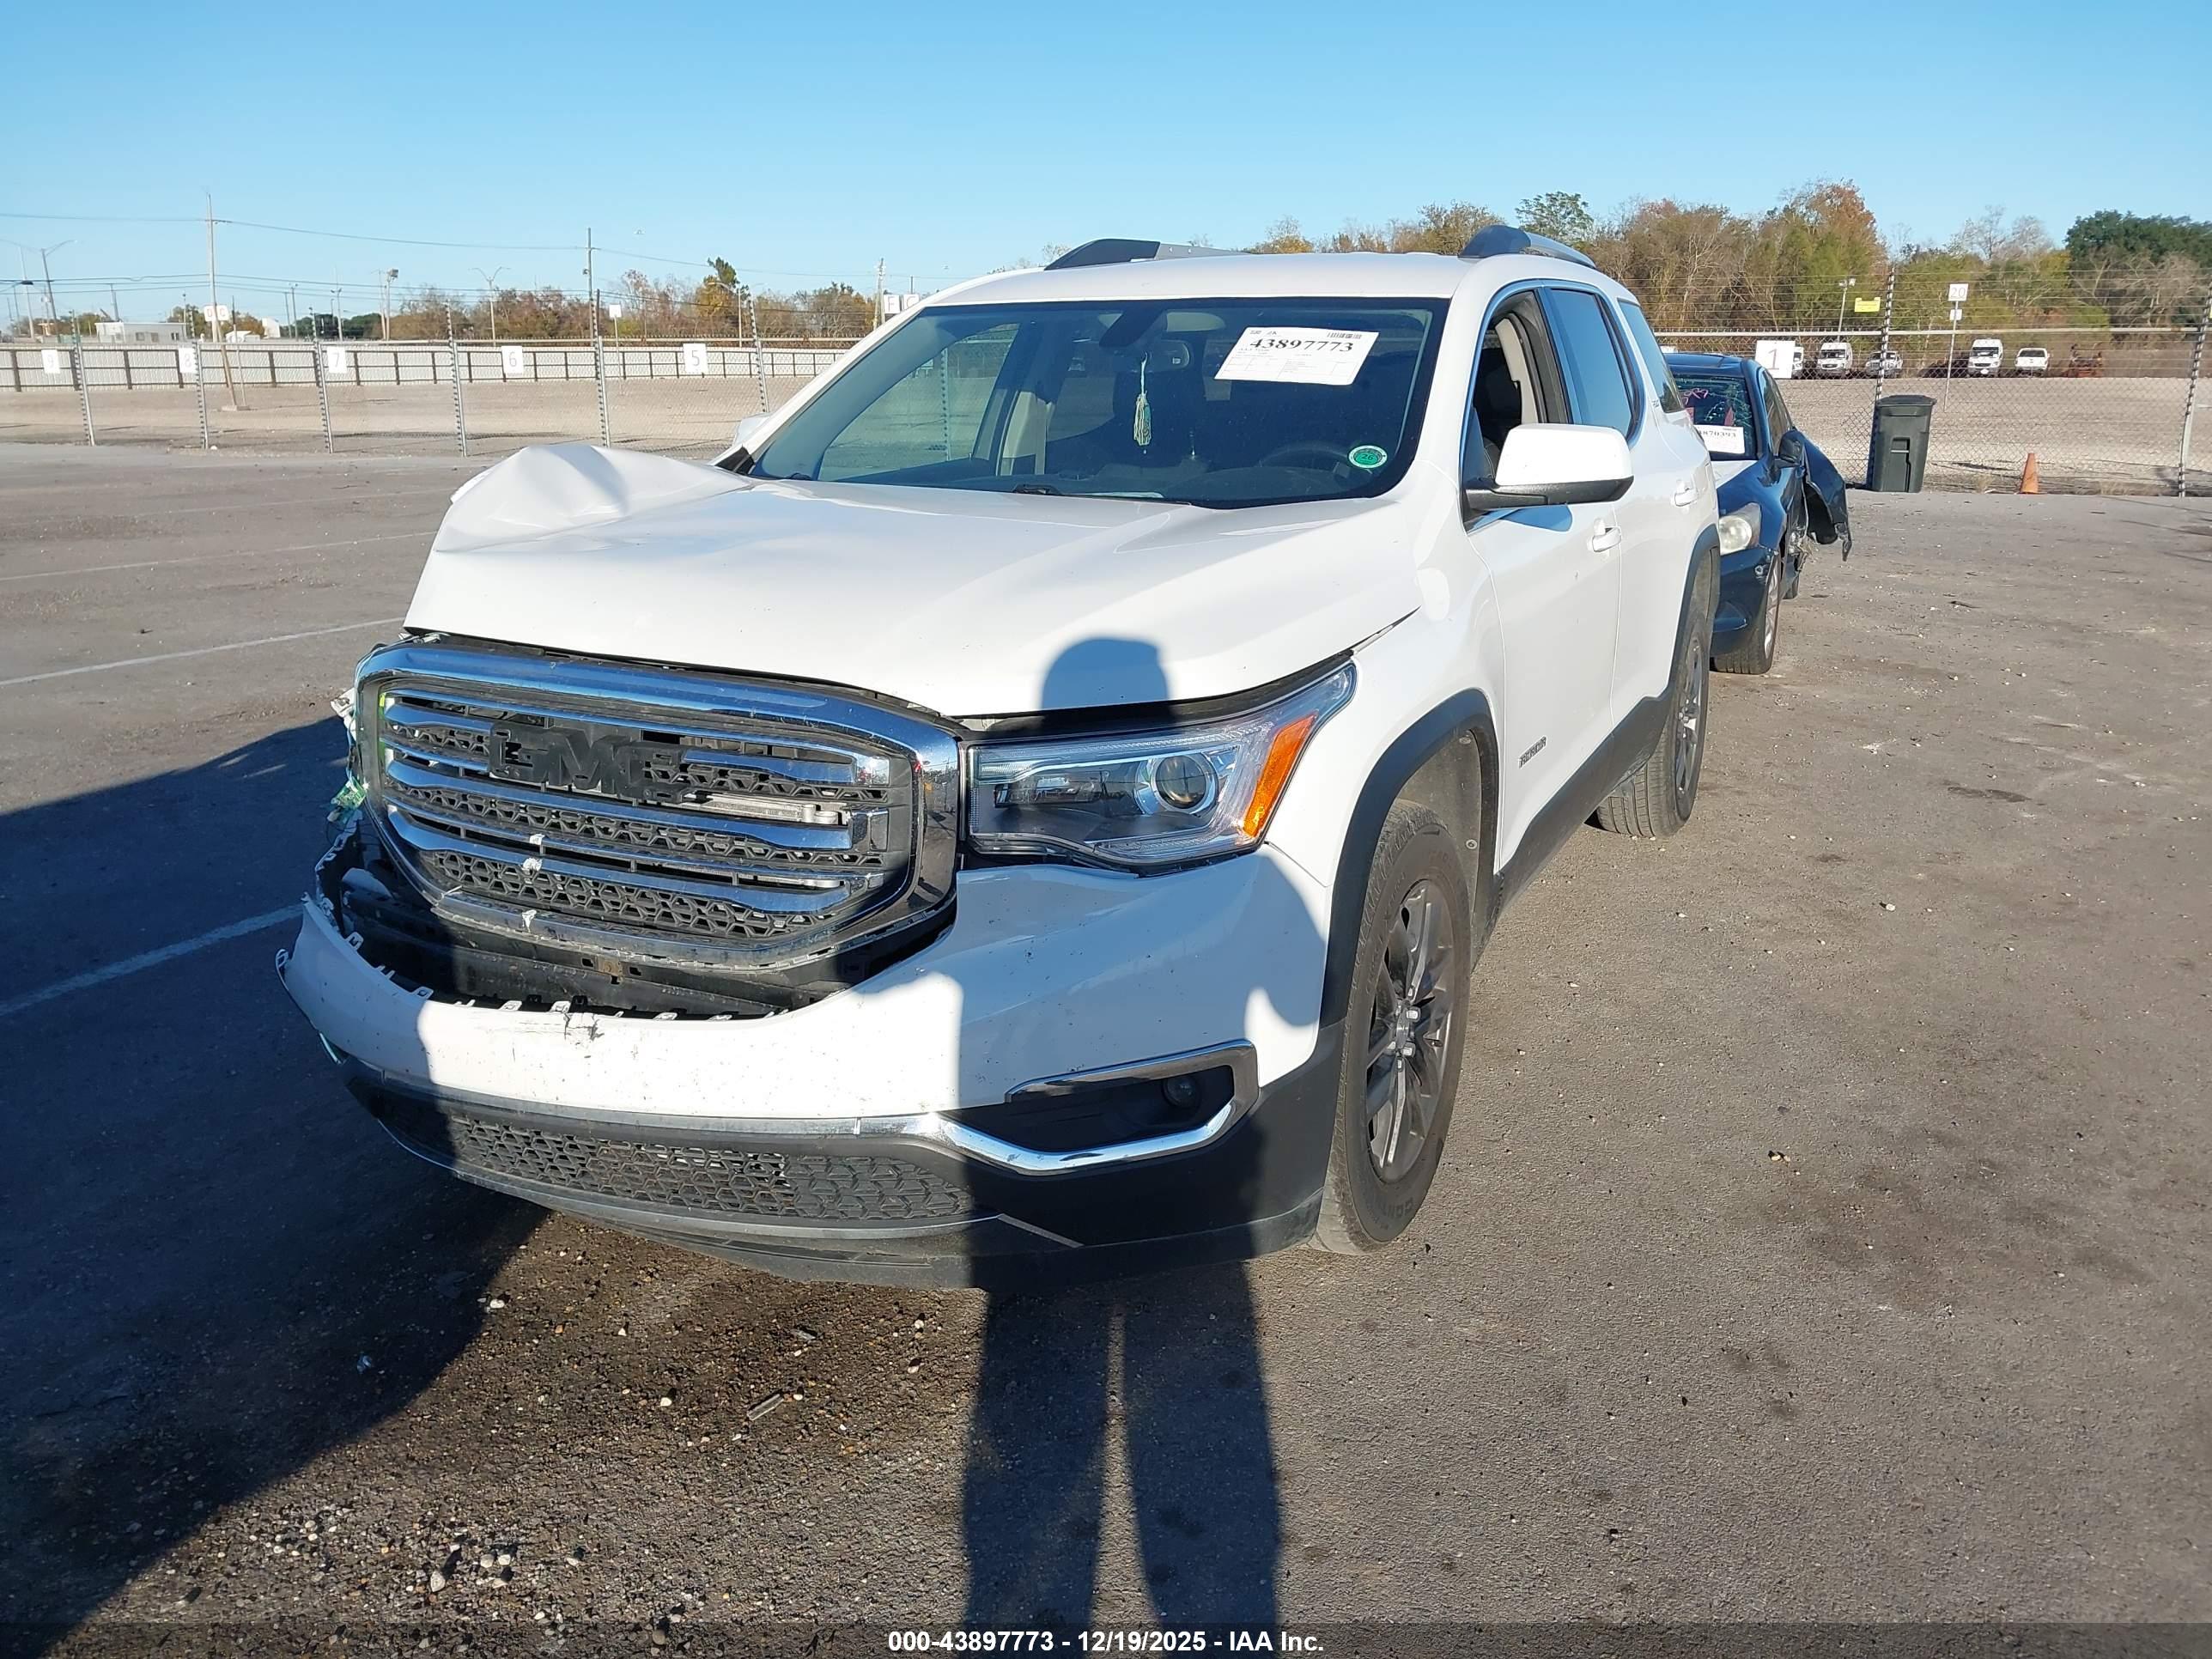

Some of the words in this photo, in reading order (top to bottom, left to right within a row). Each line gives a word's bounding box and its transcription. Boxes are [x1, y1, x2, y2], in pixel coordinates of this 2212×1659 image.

[1950, 287, 1966, 298] 20
[1249, 337, 1353, 352] 43897773
[184, 353, 192, 368] 8
[331, 352, 340, 368] 7
[508, 351, 517, 368] 6
[691, 349, 700, 367] 5
[1768, 349, 1779, 370] 1
